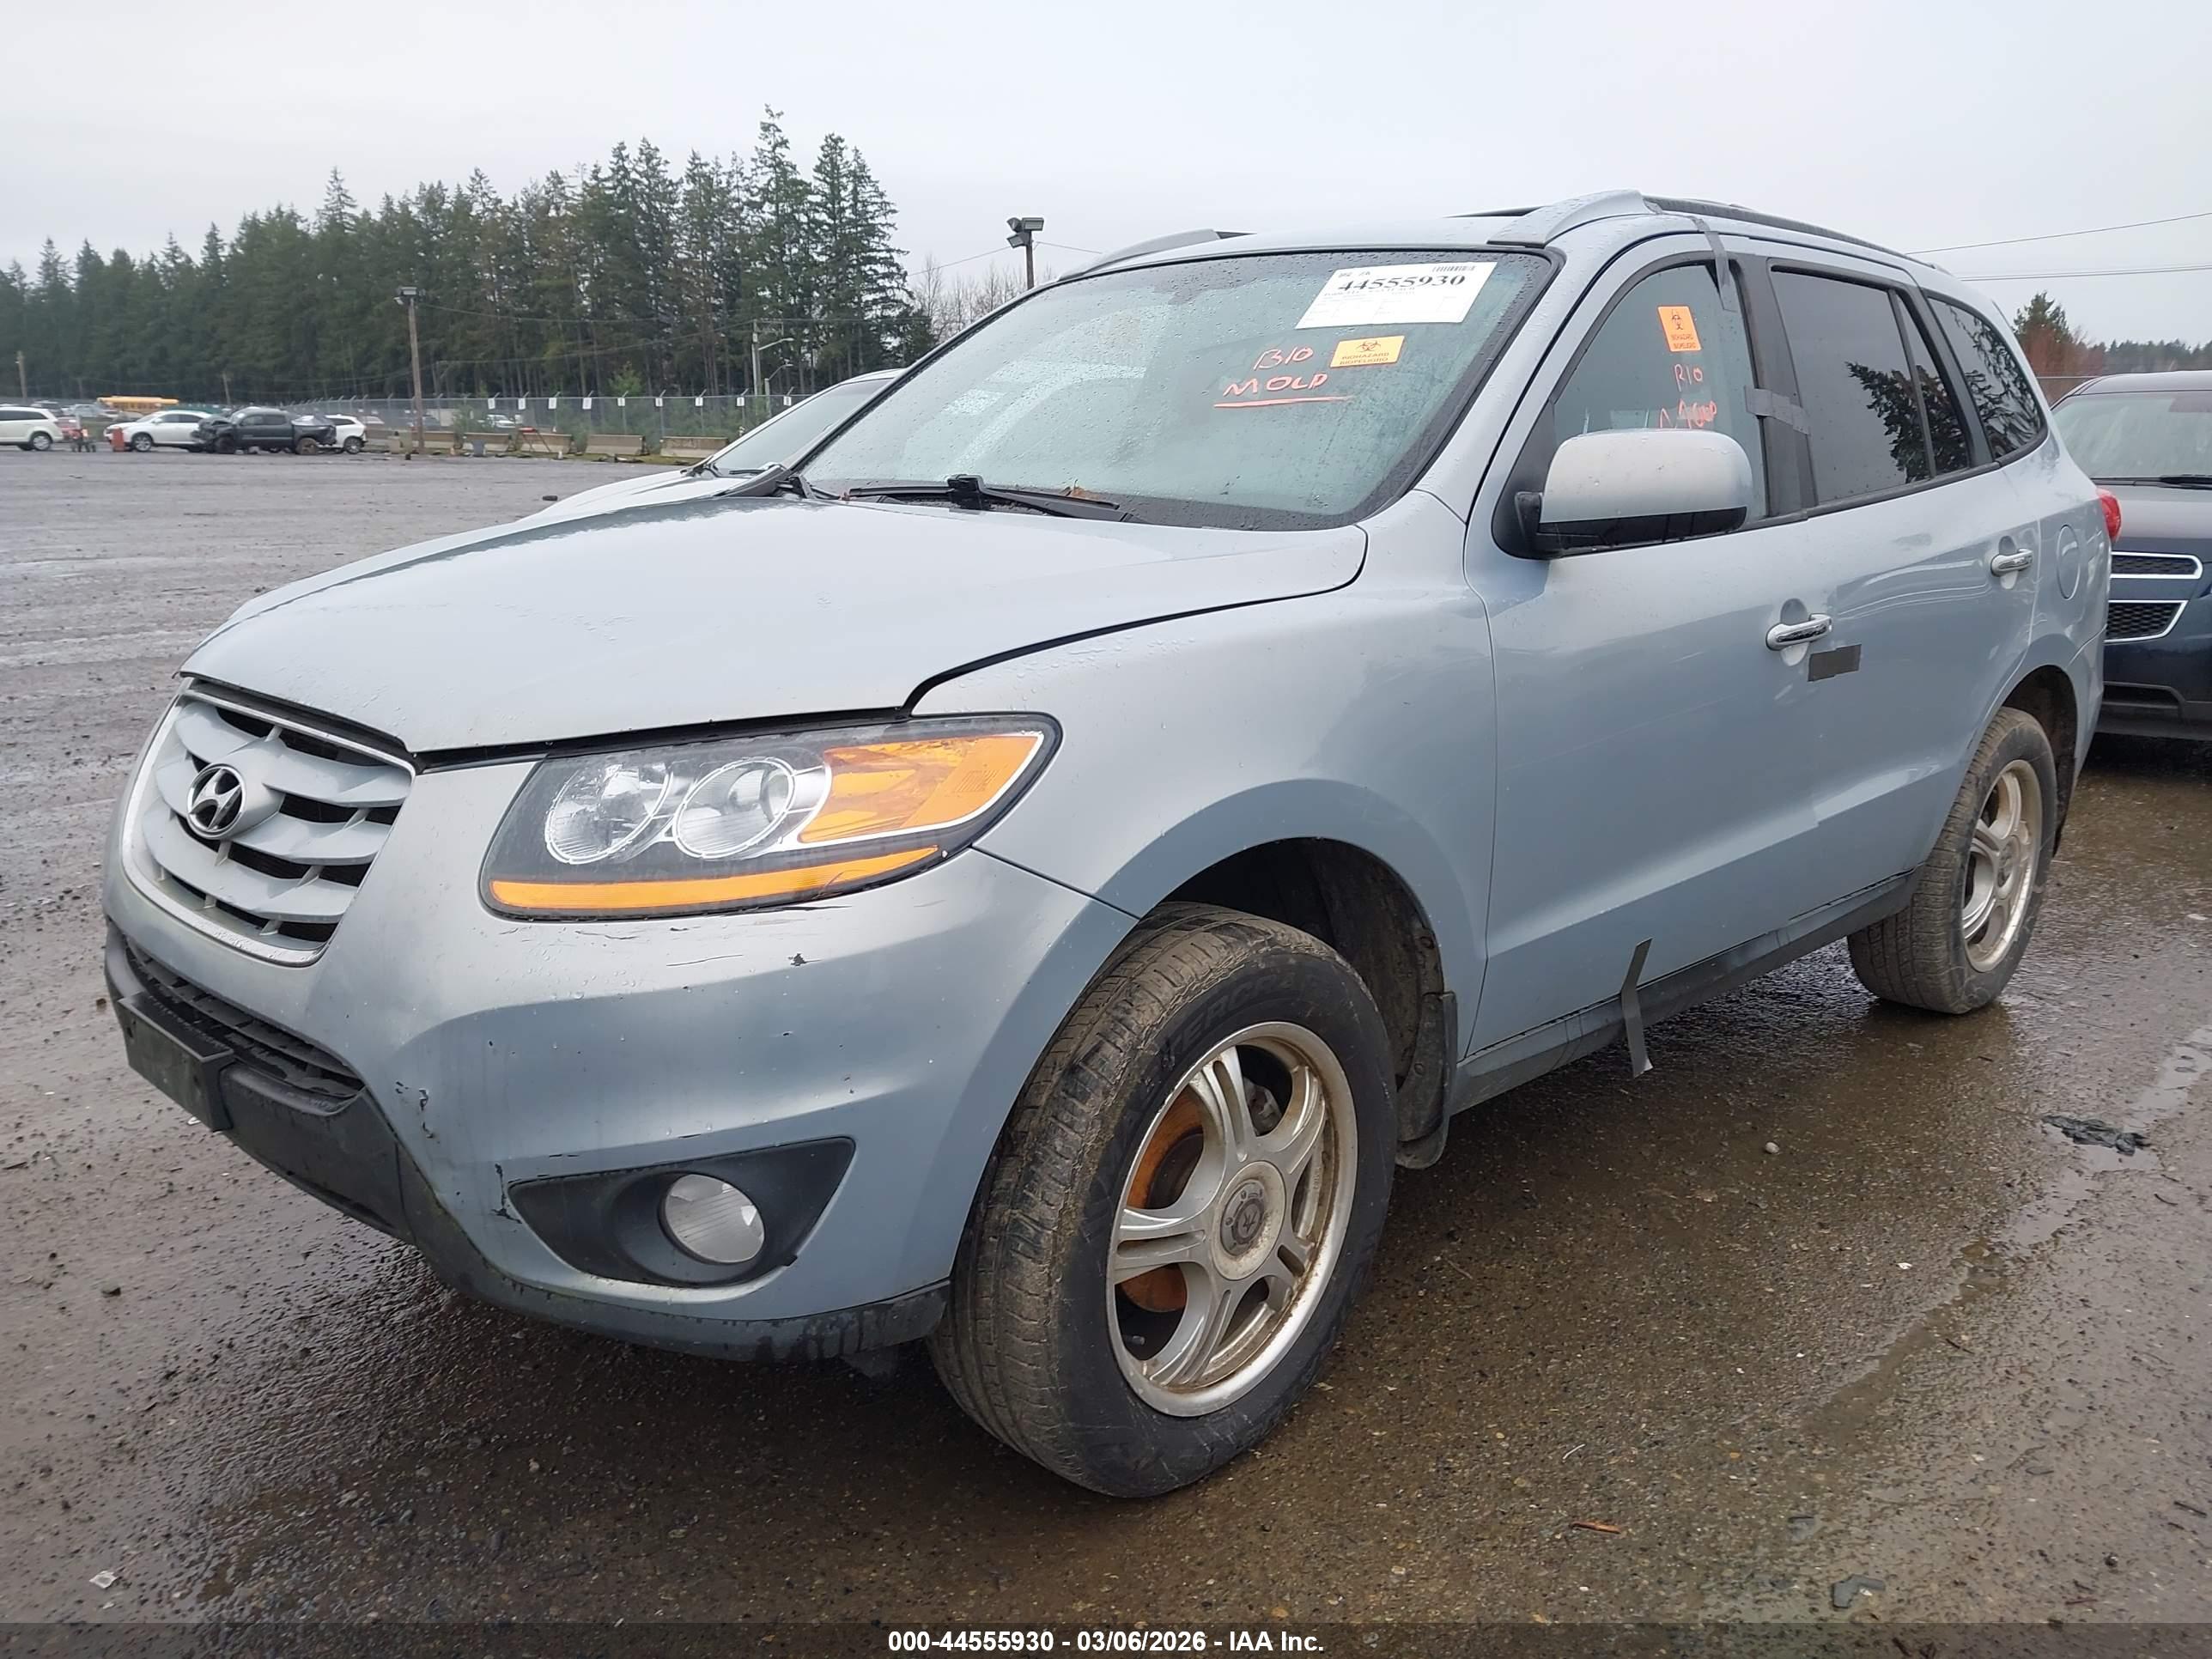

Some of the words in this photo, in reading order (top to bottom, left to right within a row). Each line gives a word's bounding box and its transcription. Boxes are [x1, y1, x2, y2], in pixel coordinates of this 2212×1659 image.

[1338, 274, 1466, 291] 44555930
[1254, 346, 1314, 370] BIO
[1223, 373, 1328, 397] MOLD
